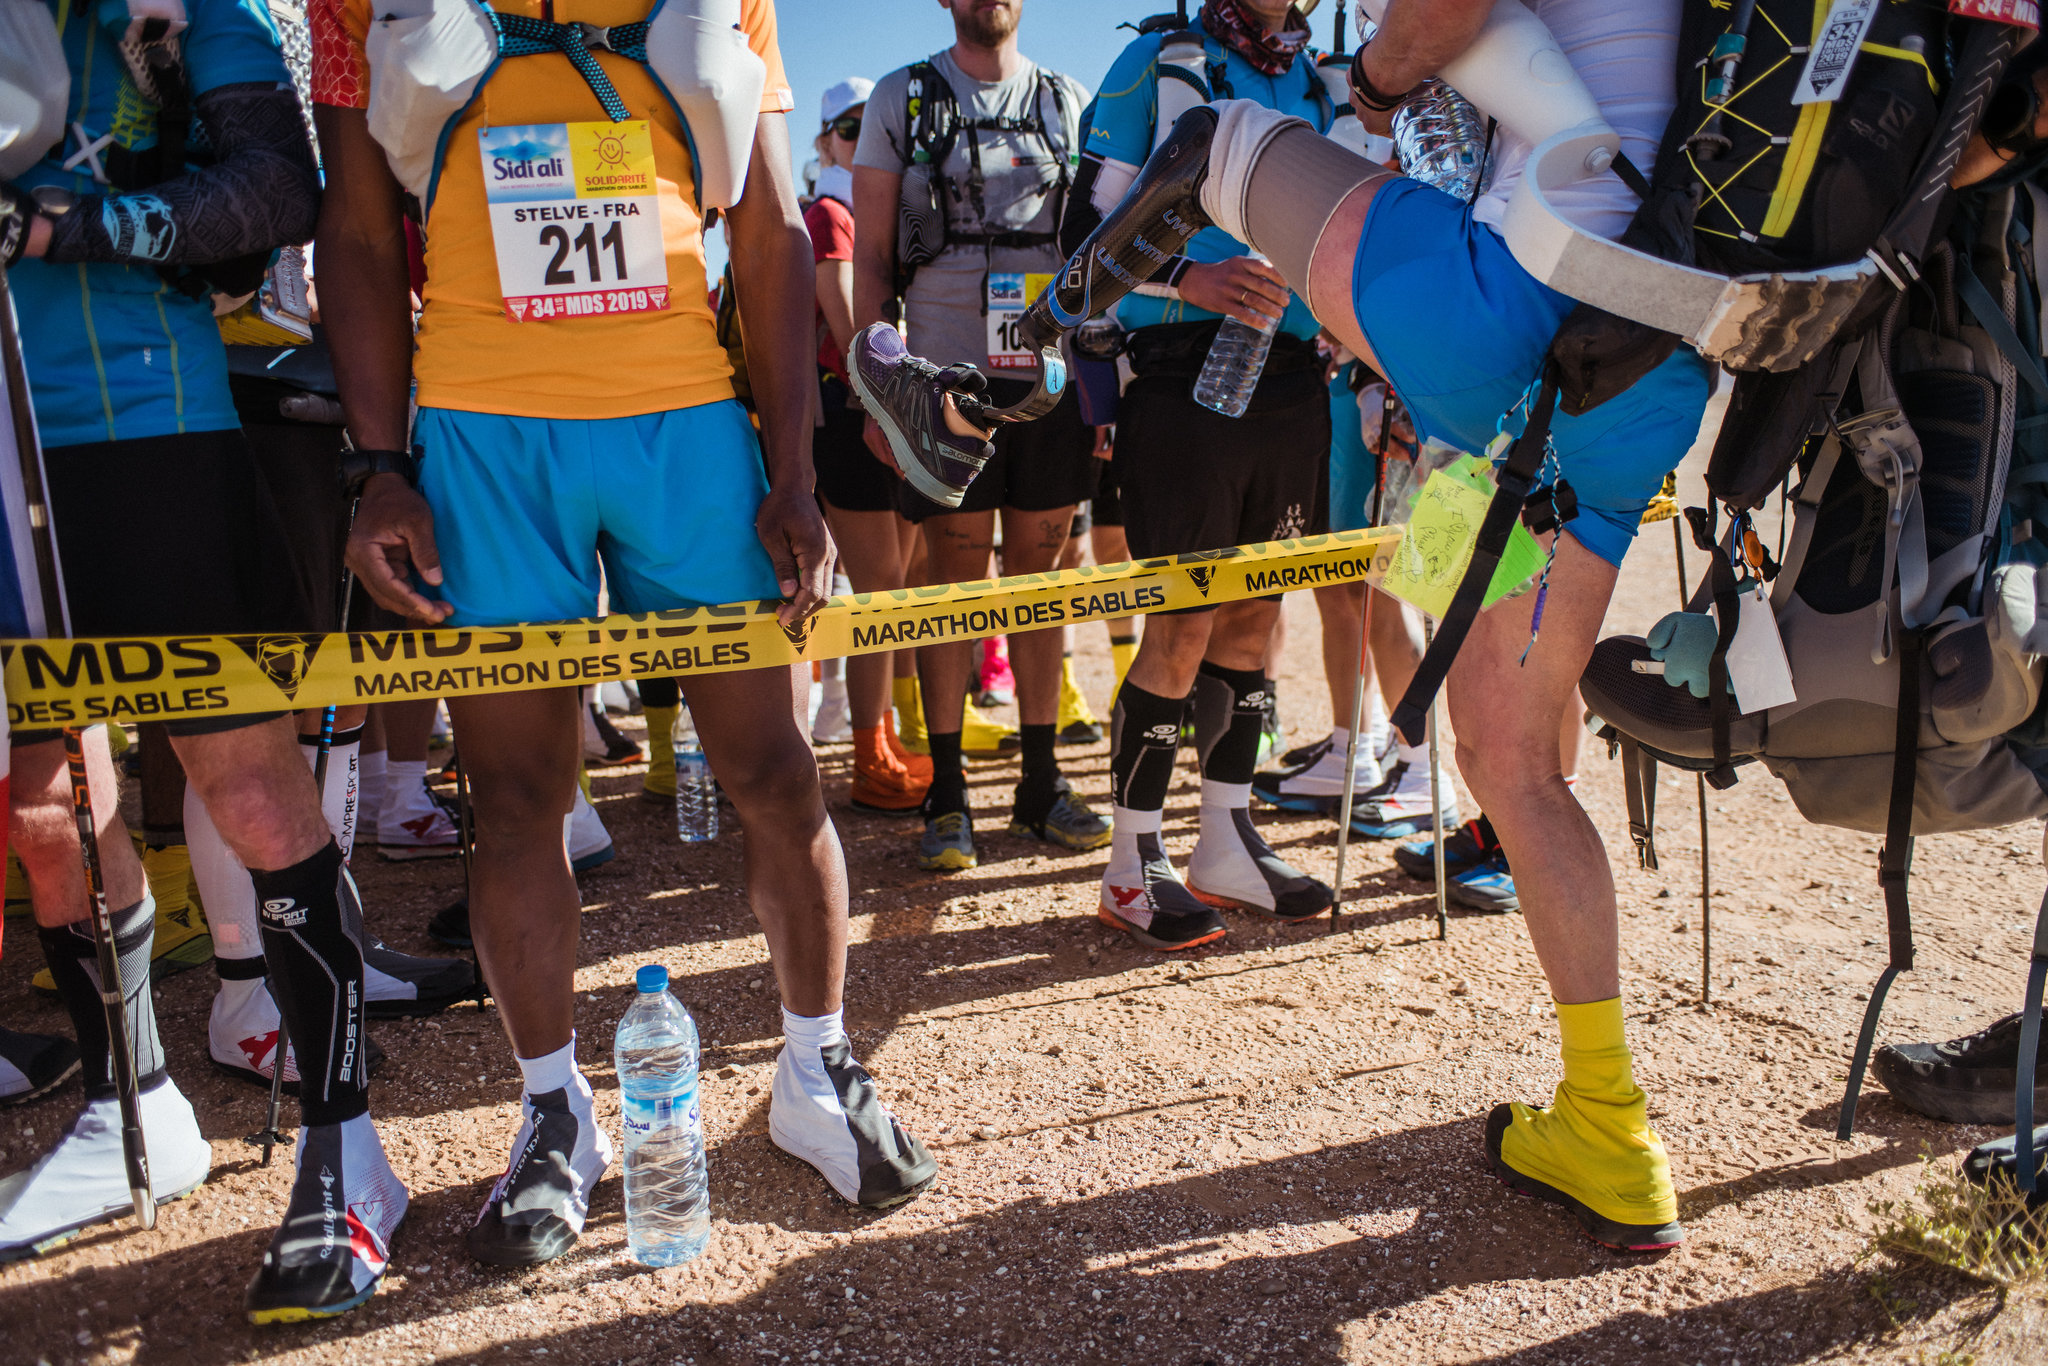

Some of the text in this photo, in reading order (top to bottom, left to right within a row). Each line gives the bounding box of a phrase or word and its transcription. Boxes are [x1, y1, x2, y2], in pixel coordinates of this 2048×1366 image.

[493, 157, 564, 181] Sidi ali
[585, 173, 648, 186] SOLIDARITÉ
[514, 205, 589, 222] STELVE
[603, 203, 640, 217] FRA
[539, 221, 628, 286] 211
[532, 297, 556, 318] 34
[566, 293, 606, 316] MDS
[608, 290, 648, 312] 2019
[997, 321, 1030, 351] 10
[1245, 557, 1371, 592] MARATHON
[852, 585, 1166, 648] MARATHON DES SABLES
[22, 637, 222, 690] MDS
[354, 642, 751, 697] MARATHON DES SABLES
[8, 686, 230, 725] DES SABLES
[340, 754, 358, 858] COMPRESSPORT
[271, 907, 309, 922] SPORT
[339, 978, 358, 1082] BOOSTER
